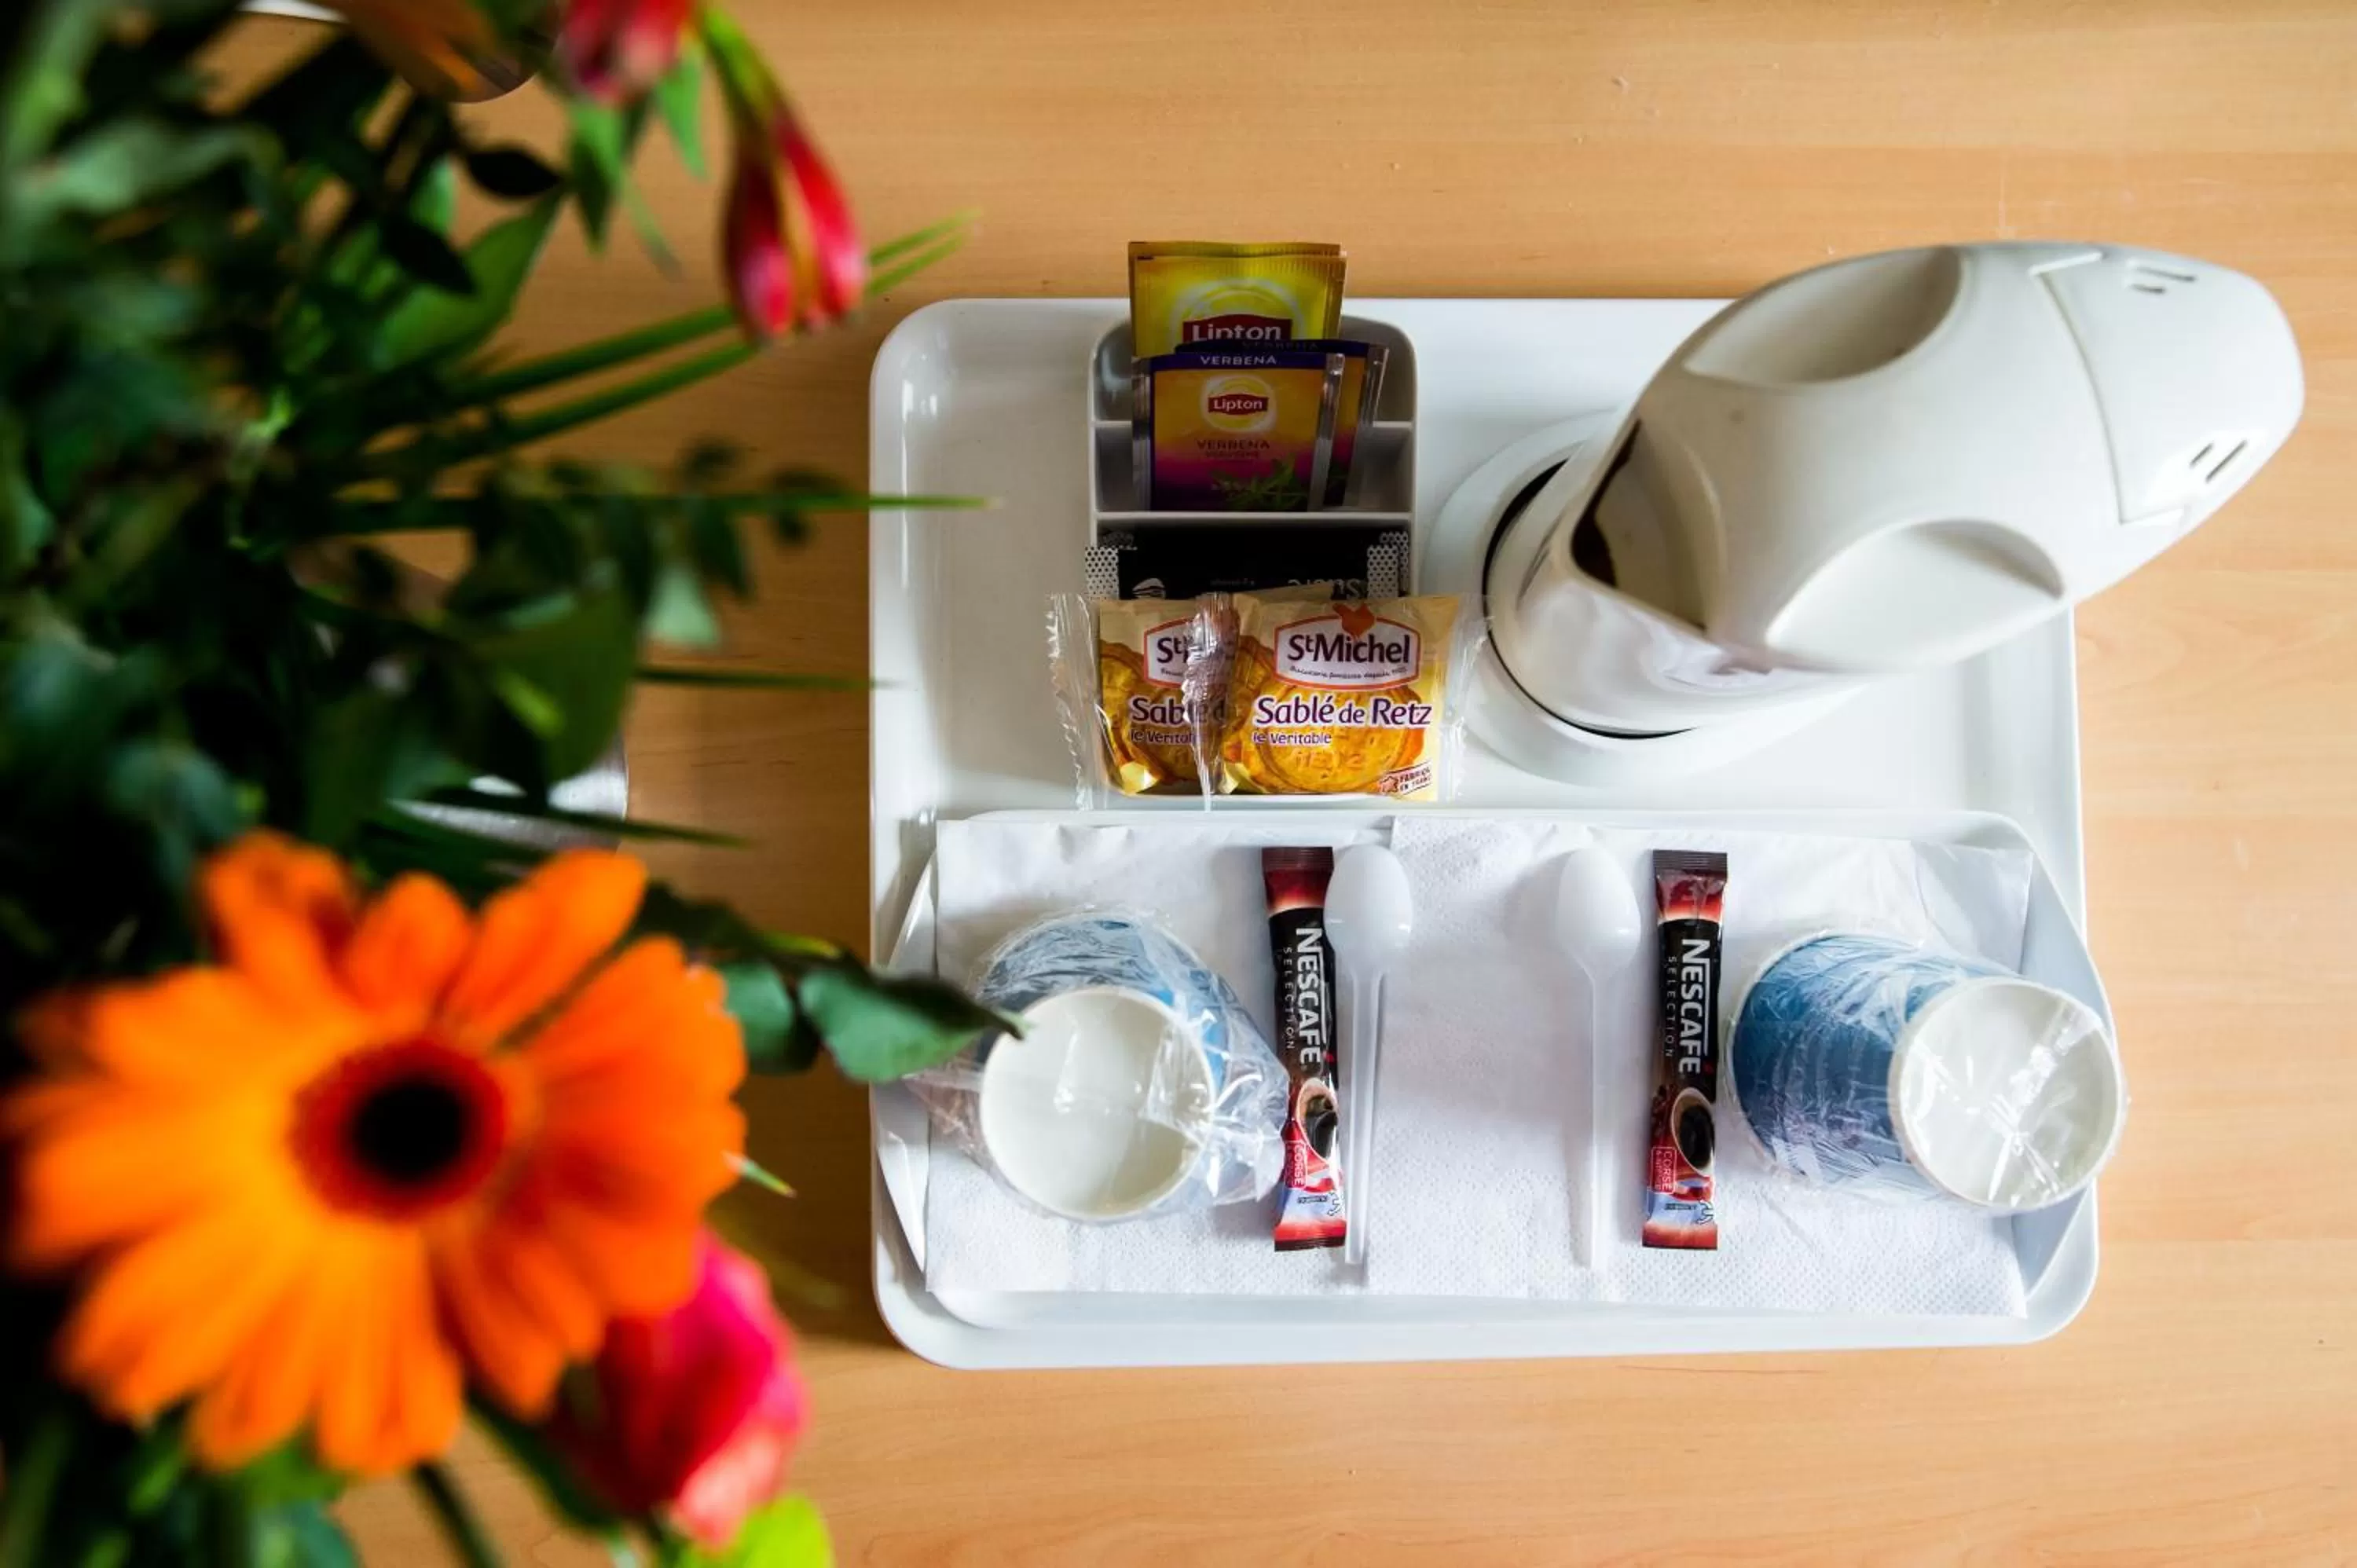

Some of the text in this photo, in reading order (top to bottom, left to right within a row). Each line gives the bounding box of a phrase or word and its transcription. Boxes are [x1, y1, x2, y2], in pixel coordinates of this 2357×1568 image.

[1192, 324, 1281, 341] Lipton
[1200, 355, 1277, 365] VERBENA
[1213, 398, 1263, 412] Lipton
[1256, 695, 1433, 725] Sablé de Retz
[1253, 732, 1266, 743] le
